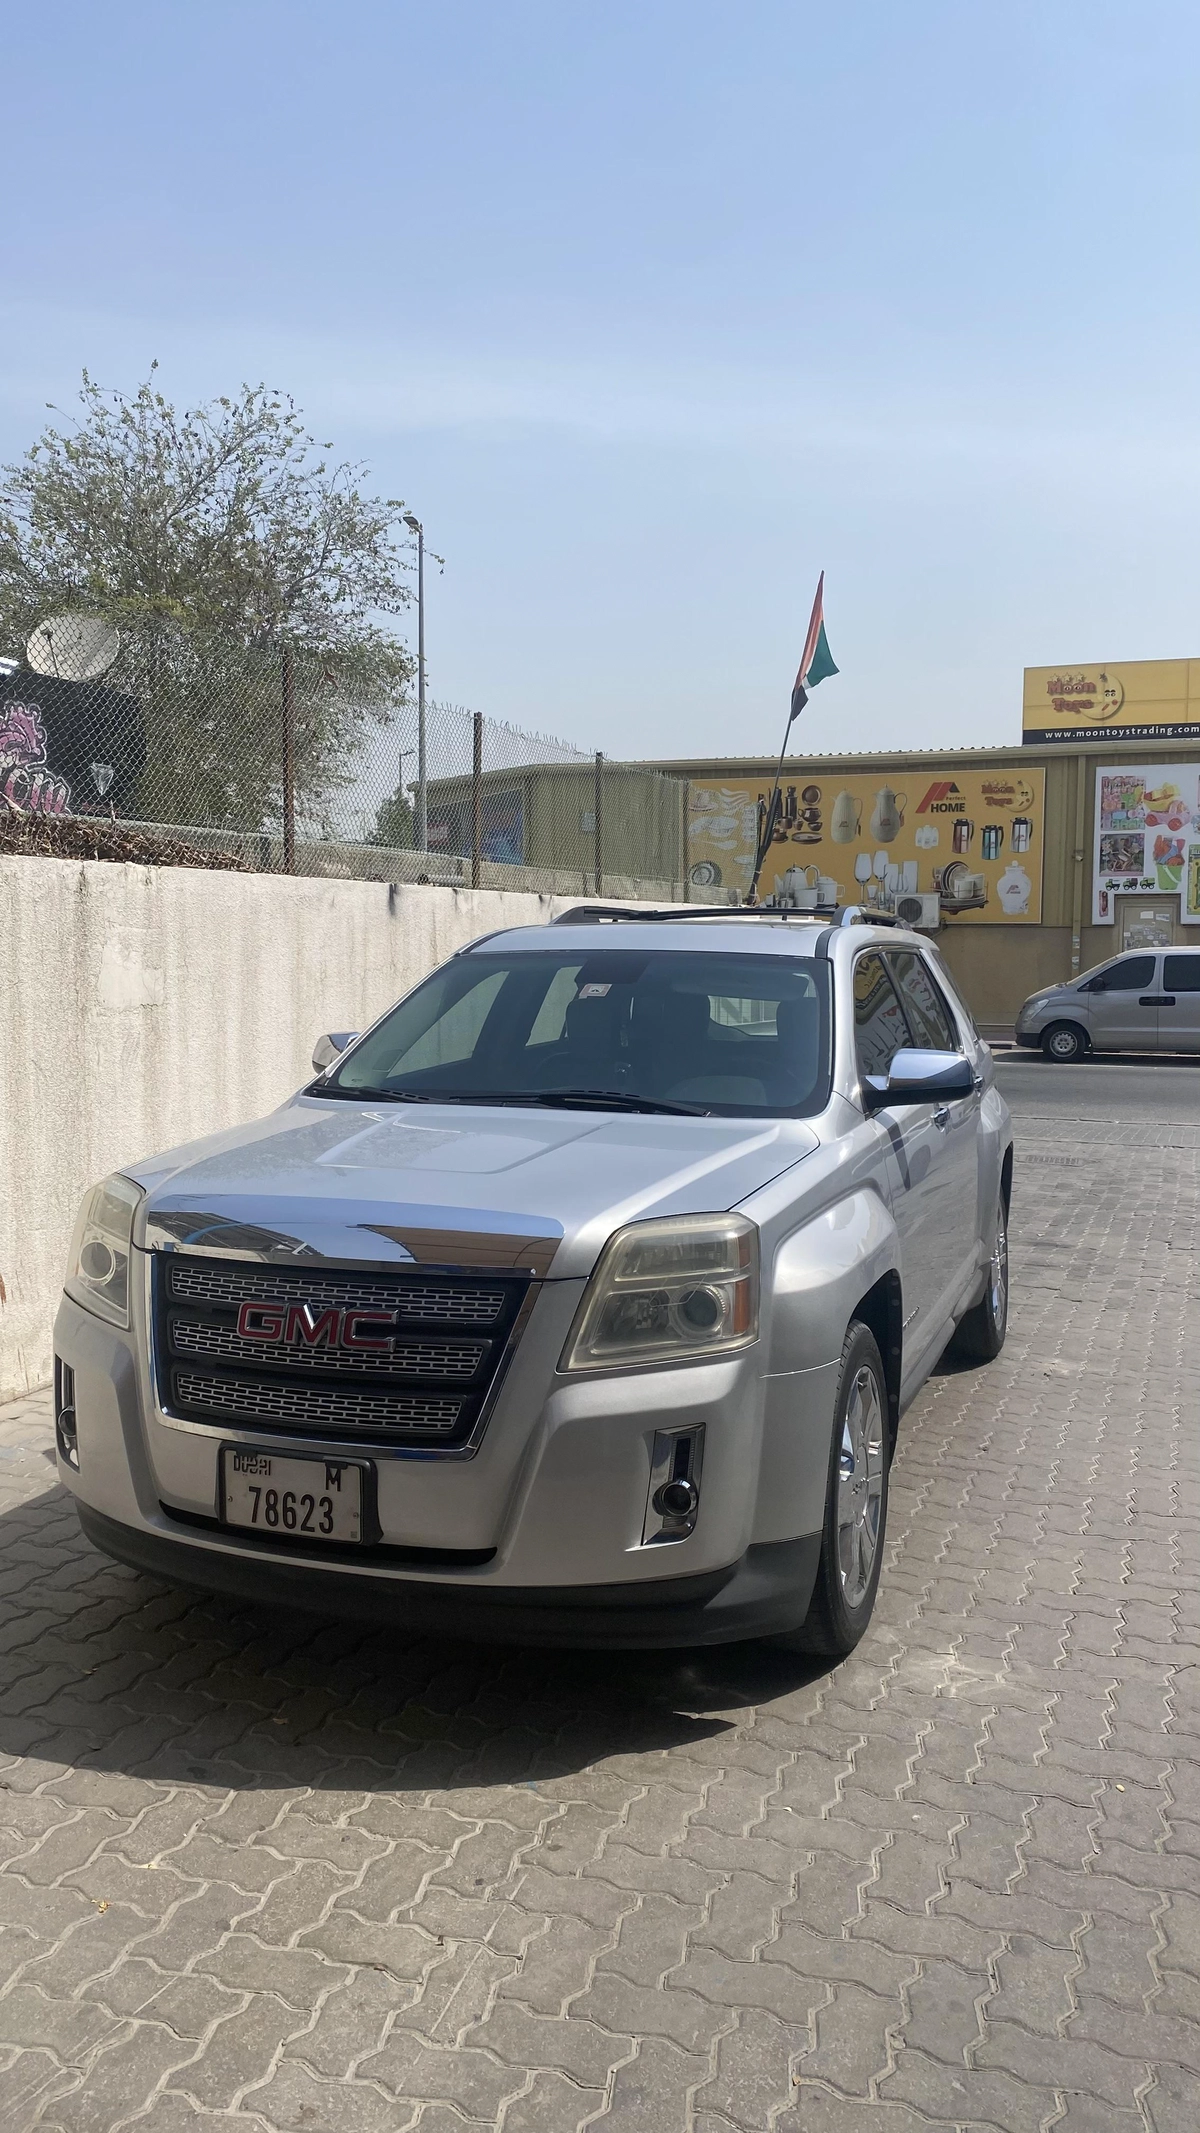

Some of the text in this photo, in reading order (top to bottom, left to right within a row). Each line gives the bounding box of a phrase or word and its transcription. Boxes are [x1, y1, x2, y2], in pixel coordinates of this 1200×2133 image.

[1047, 680, 1097, 696] Moon
[1051, 697, 1094, 714] Toys
[1045, 725, 1200, 739] www.moontoystrading.com
[930, 802, 966, 813] HOME
[238, 1300, 400, 1353] GMC
[325, 1466, 342, 1492] M
[248, 1485, 334, 1535] 78623
